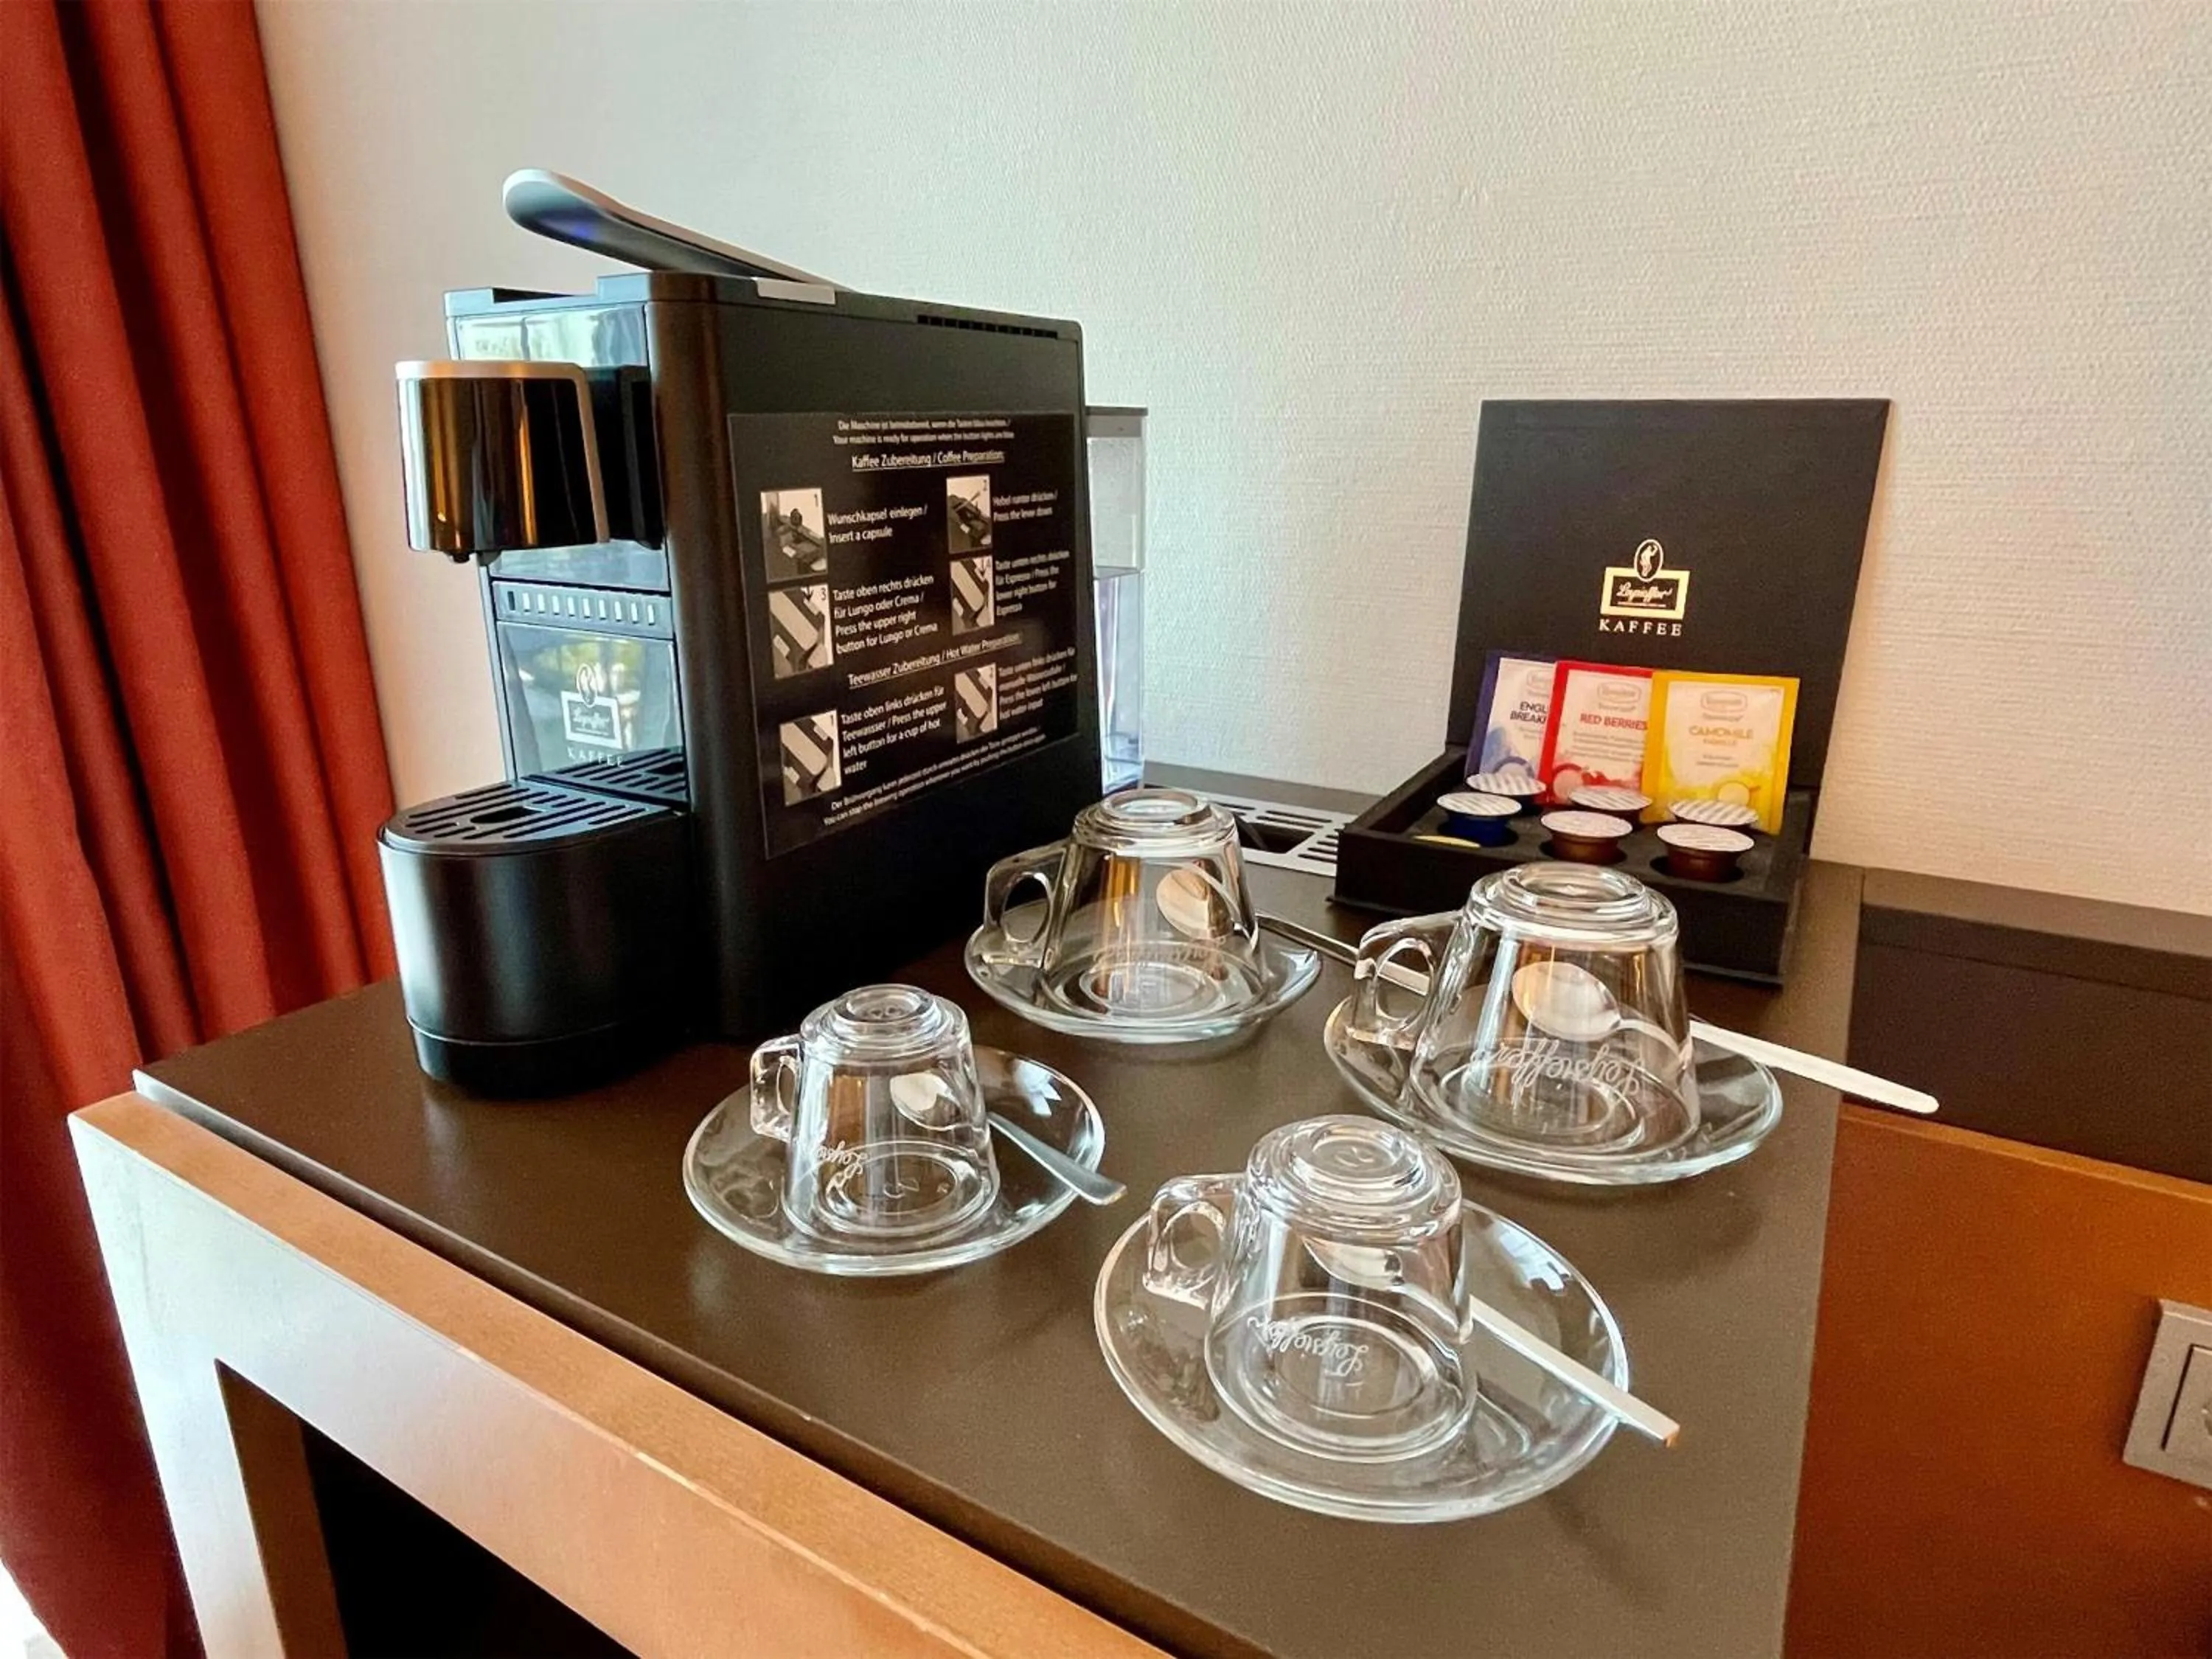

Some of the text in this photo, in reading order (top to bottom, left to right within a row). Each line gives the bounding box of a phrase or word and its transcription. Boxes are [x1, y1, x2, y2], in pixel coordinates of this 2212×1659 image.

[852, 454, 880, 469] Kaffee
[880, 453, 931, 467] Zubereitung
[937, 451, 961, 465] Coffee
[827, 507, 888, 526] Wunschkapsel
[888, 506, 923, 520] einlegen
[829, 526, 893, 544] Insert a capsule
[821, 587, 827, 601] 3
[832, 574, 934, 602] Taste oben rechts drücken
[834, 605, 847, 620] für
[847, 603, 875, 618] Lungo
[874, 599, 894, 611] oder
[894, 594, 919, 608] Crema
[835, 610, 917, 638] Press the upper right
[1599, 619, 1683, 636] KAFFEE
[835, 623, 939, 655] button for Lungo or Crema
[847, 666, 892, 686] Teewasser
[891, 654, 941, 675] Zubereitung
[945, 647, 961, 661] Hot
[841, 685, 945, 726] Taste oben links drücken für
[1520, 700, 1548, 714] ENGL
[842, 721, 887, 742] Teewasser
[891, 712, 913, 726] Press
[912, 707, 926, 720] the
[925, 700, 947, 717] upper
[1509, 710, 1547, 724] BREAK
[1580, 712, 1649, 731] RED BERRIES
[842, 744, 858, 759] left
[858, 737, 887, 755] button
[886, 731, 898, 745] for
[904, 726, 920, 740] cup
[919, 720, 928, 734] of
[927, 717, 941, 730] hot
[1688, 725, 1754, 740] CAMOMILE
[844, 760, 869, 775] water
